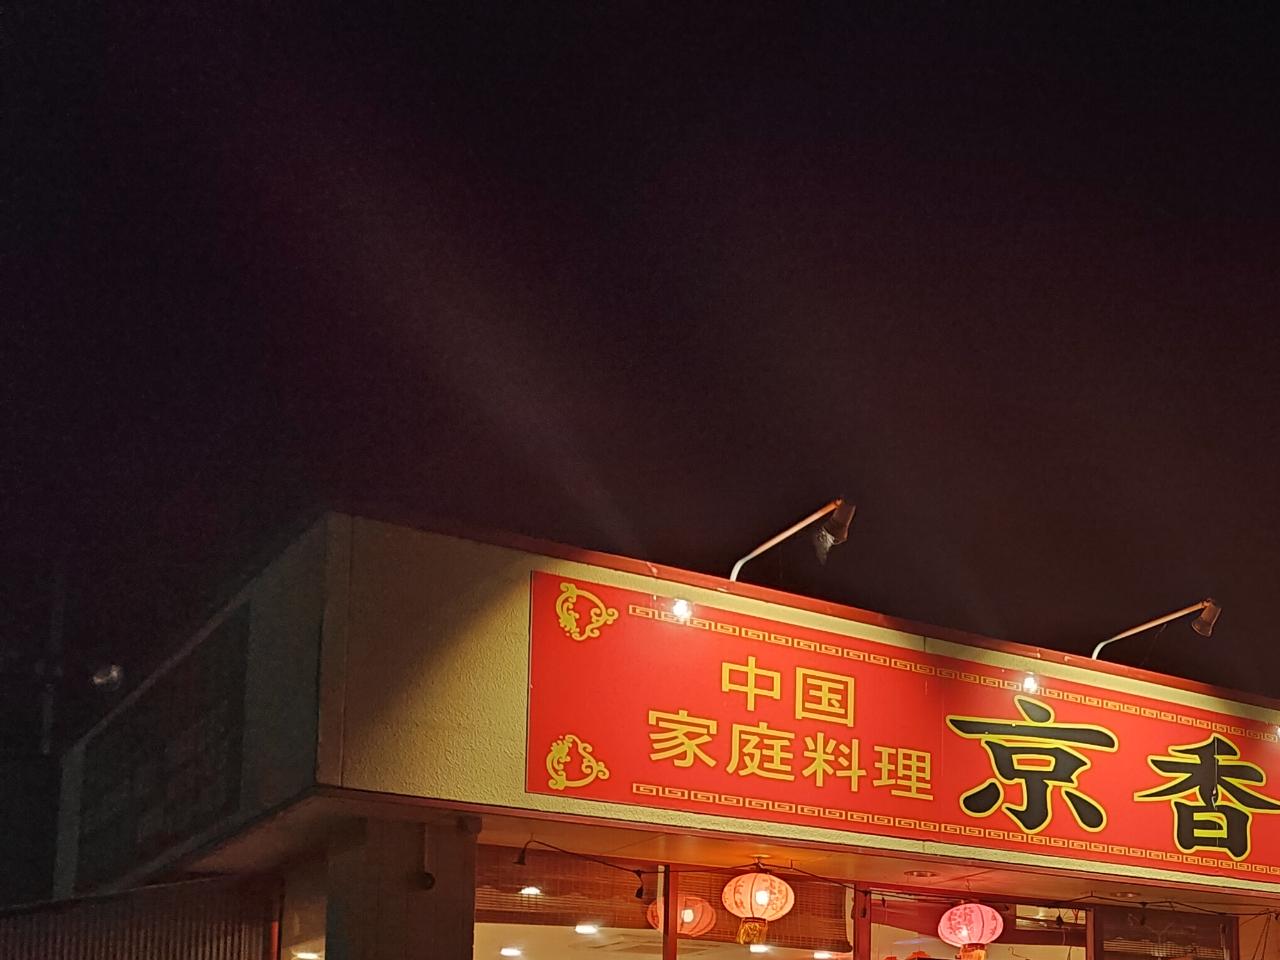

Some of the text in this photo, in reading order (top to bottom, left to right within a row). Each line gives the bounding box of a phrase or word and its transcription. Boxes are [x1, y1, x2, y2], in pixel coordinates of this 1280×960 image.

[721, 655, 856, 728] 中国
[648, 709, 934, 801] 家庭料理
